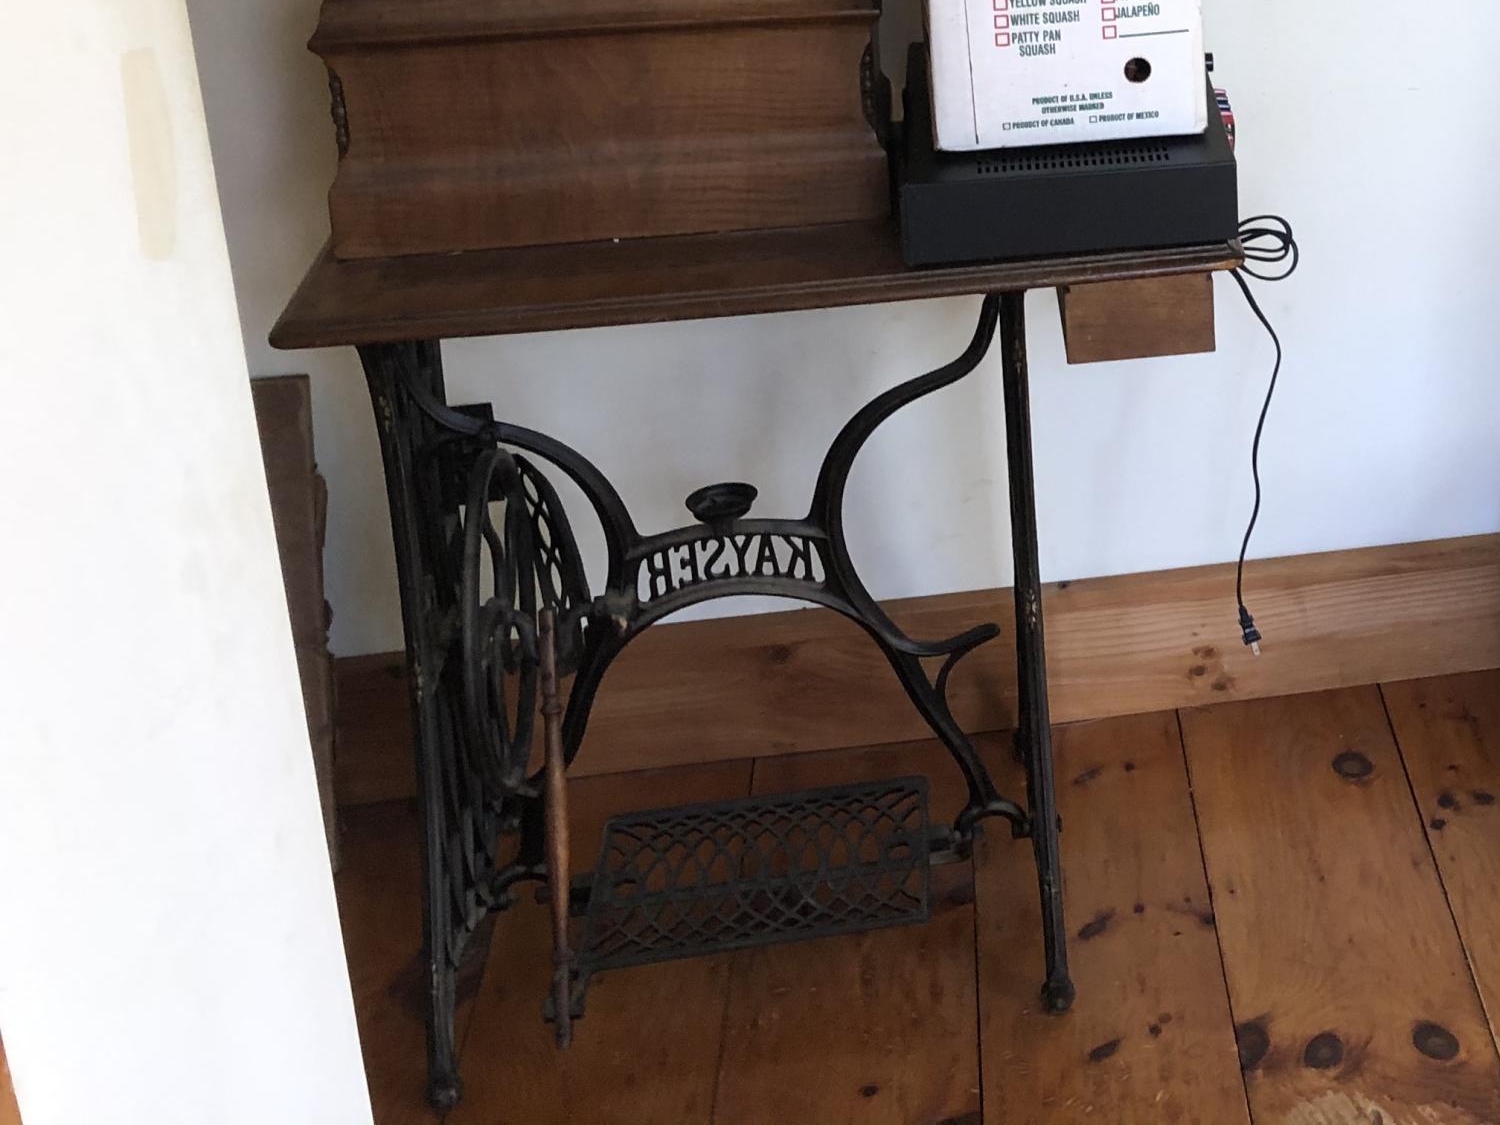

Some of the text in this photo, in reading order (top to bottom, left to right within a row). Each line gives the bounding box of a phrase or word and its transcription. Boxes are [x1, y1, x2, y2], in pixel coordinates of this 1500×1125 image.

[1115, 1, 1160, 19] JALAPEÑO
[1010, 9, 1081, 27] WHITE SQUASH
[1011, 28, 1062, 45] PATTY PAN
[1019, 42, 1056, 58] SQUASH
[1031, 91, 1113, 106] PRODUCT OF U.S.A. UNLESS
[1041, 101, 1105, 114] OTHERWISE MARKED
[1012, 117, 1075, 129] PRODUCT OF CANADA
[1098, 110, 1160, 123] PRODUCT OF MEXICO
